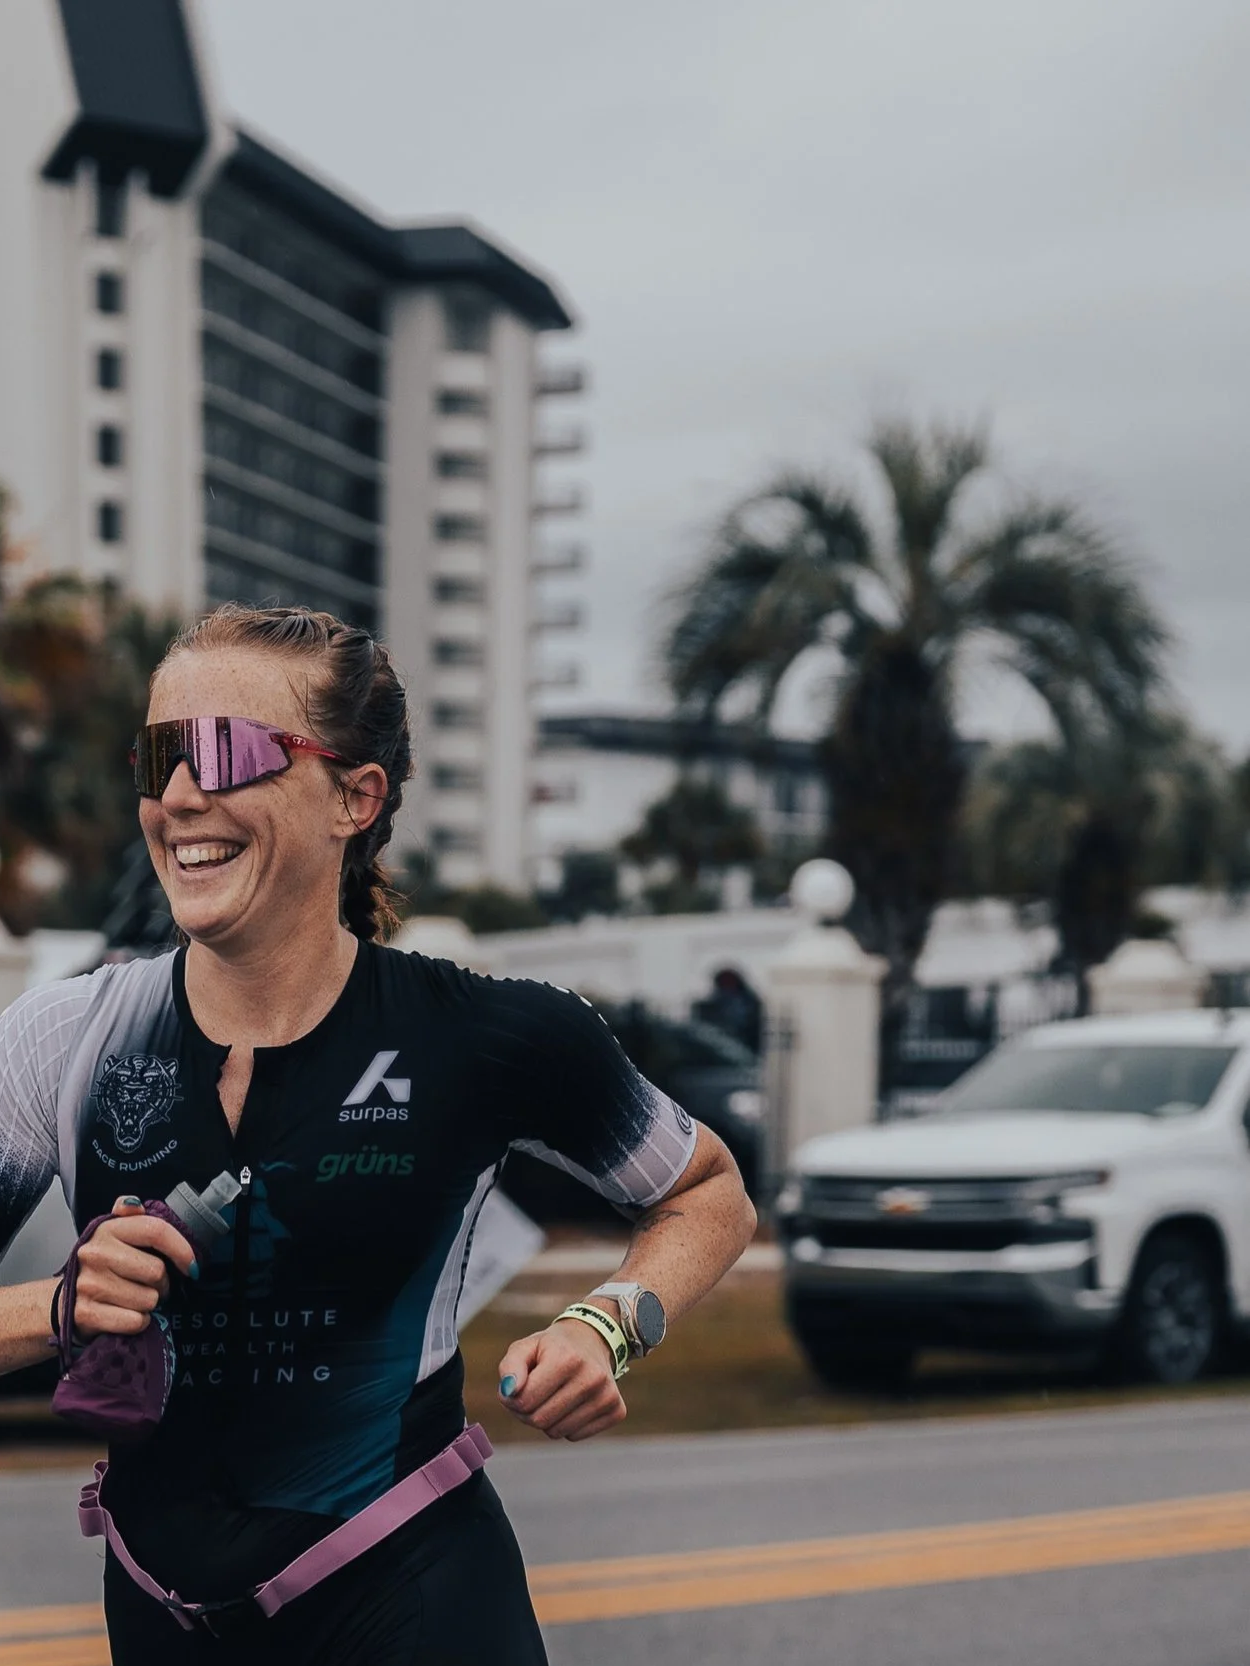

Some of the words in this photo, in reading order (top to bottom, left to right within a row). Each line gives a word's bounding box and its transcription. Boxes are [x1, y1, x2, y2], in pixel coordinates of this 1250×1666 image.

[338, 1106, 409, 1123] surpas
[92, 1139, 117, 1169] PACE
[119, 1139, 178, 1172] RUNNING
[315, 1144, 416, 1183] grüns
[172, 1309, 337, 1331] ESOLUTE
[180, 1365, 331, 1388] ACING
